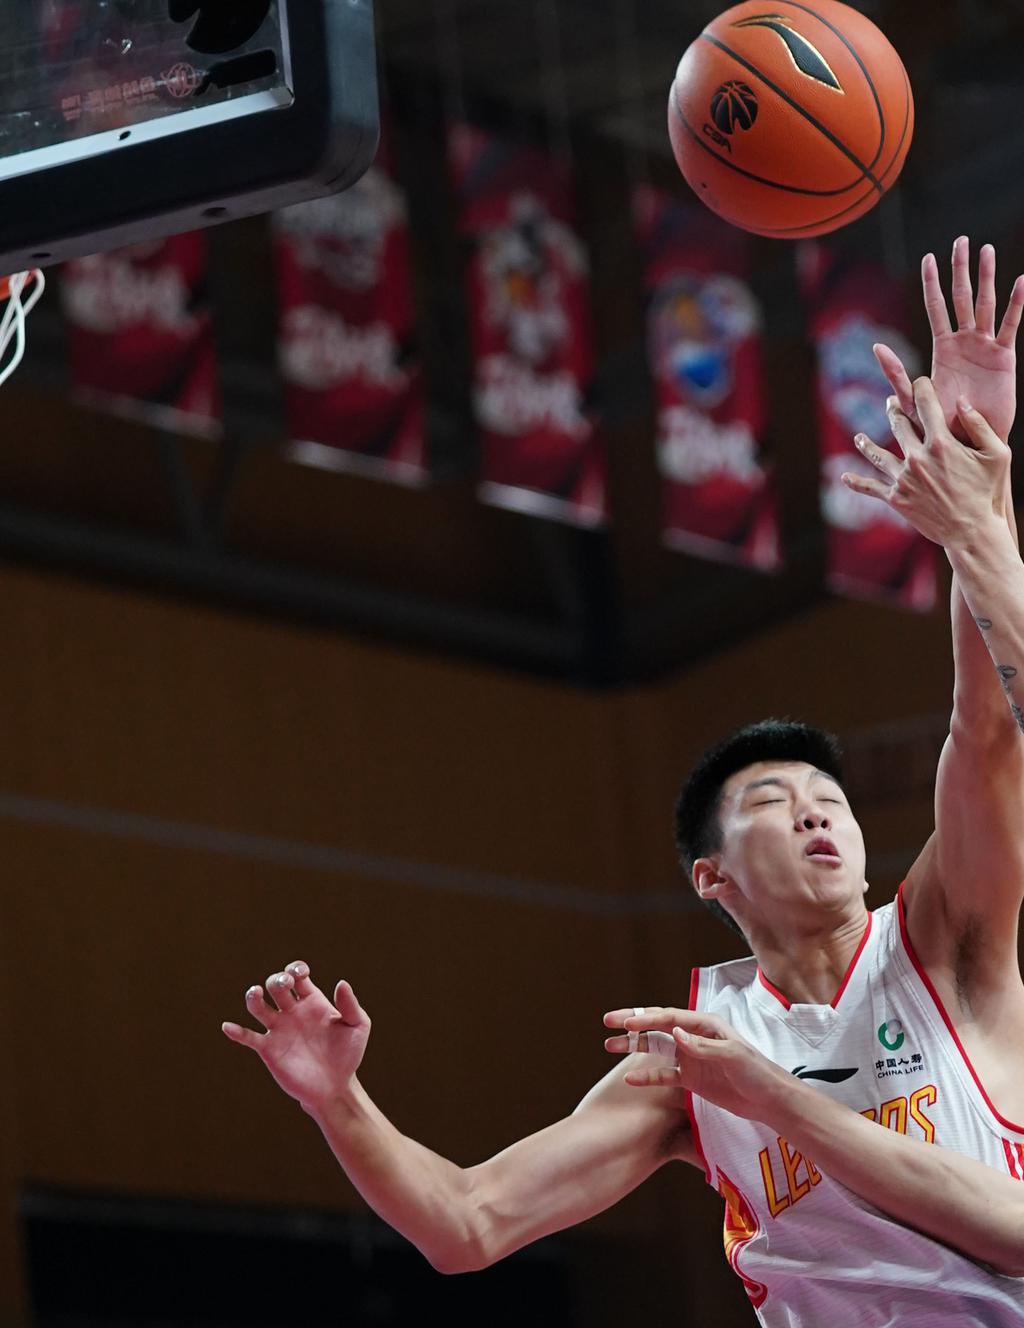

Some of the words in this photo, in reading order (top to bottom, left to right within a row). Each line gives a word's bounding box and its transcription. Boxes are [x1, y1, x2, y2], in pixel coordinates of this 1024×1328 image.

[875, 1053, 922, 1071] 中国人寿
[877, 1068, 904, 1079] CHINA
[904, 1064, 924, 1075] LIFE
